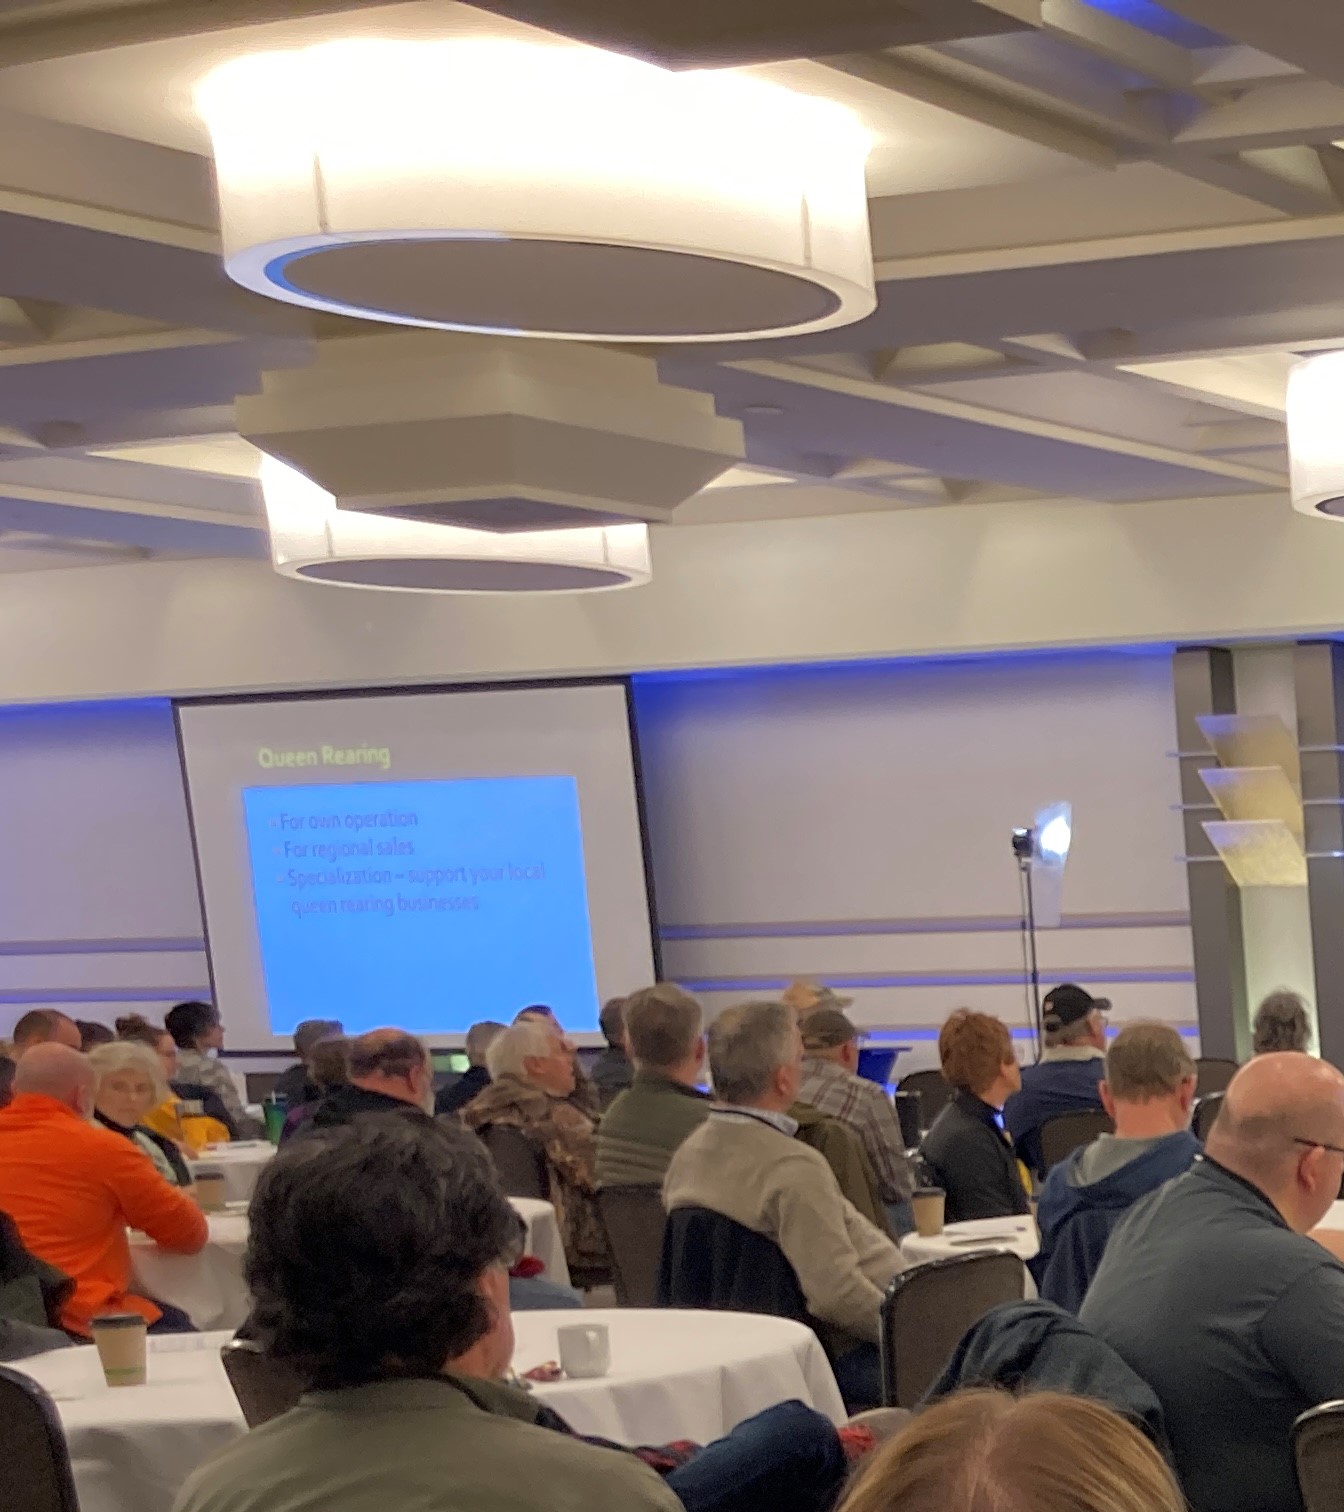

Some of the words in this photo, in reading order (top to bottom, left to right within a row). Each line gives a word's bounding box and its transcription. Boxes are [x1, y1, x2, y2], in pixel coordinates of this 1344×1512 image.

[258, 748, 317, 769] Queen
[322, 744, 391, 769] Rearing
[280, 813, 304, 830] For
[309, 815, 340, 829] own
[345, 810, 418, 832] operation
[284, 841, 307, 858] For
[312, 838, 373, 863] regional
[377, 837, 415, 856] sales
[288, 869, 391, 890] Specialization
[408, 866, 466, 886] support
[468, 867, 503, 886] your
[508, 862, 545, 881] local
[291, 899, 337, 918] queen
[340, 896, 394, 917] rearing
[397, 891, 479, 912] businesses
